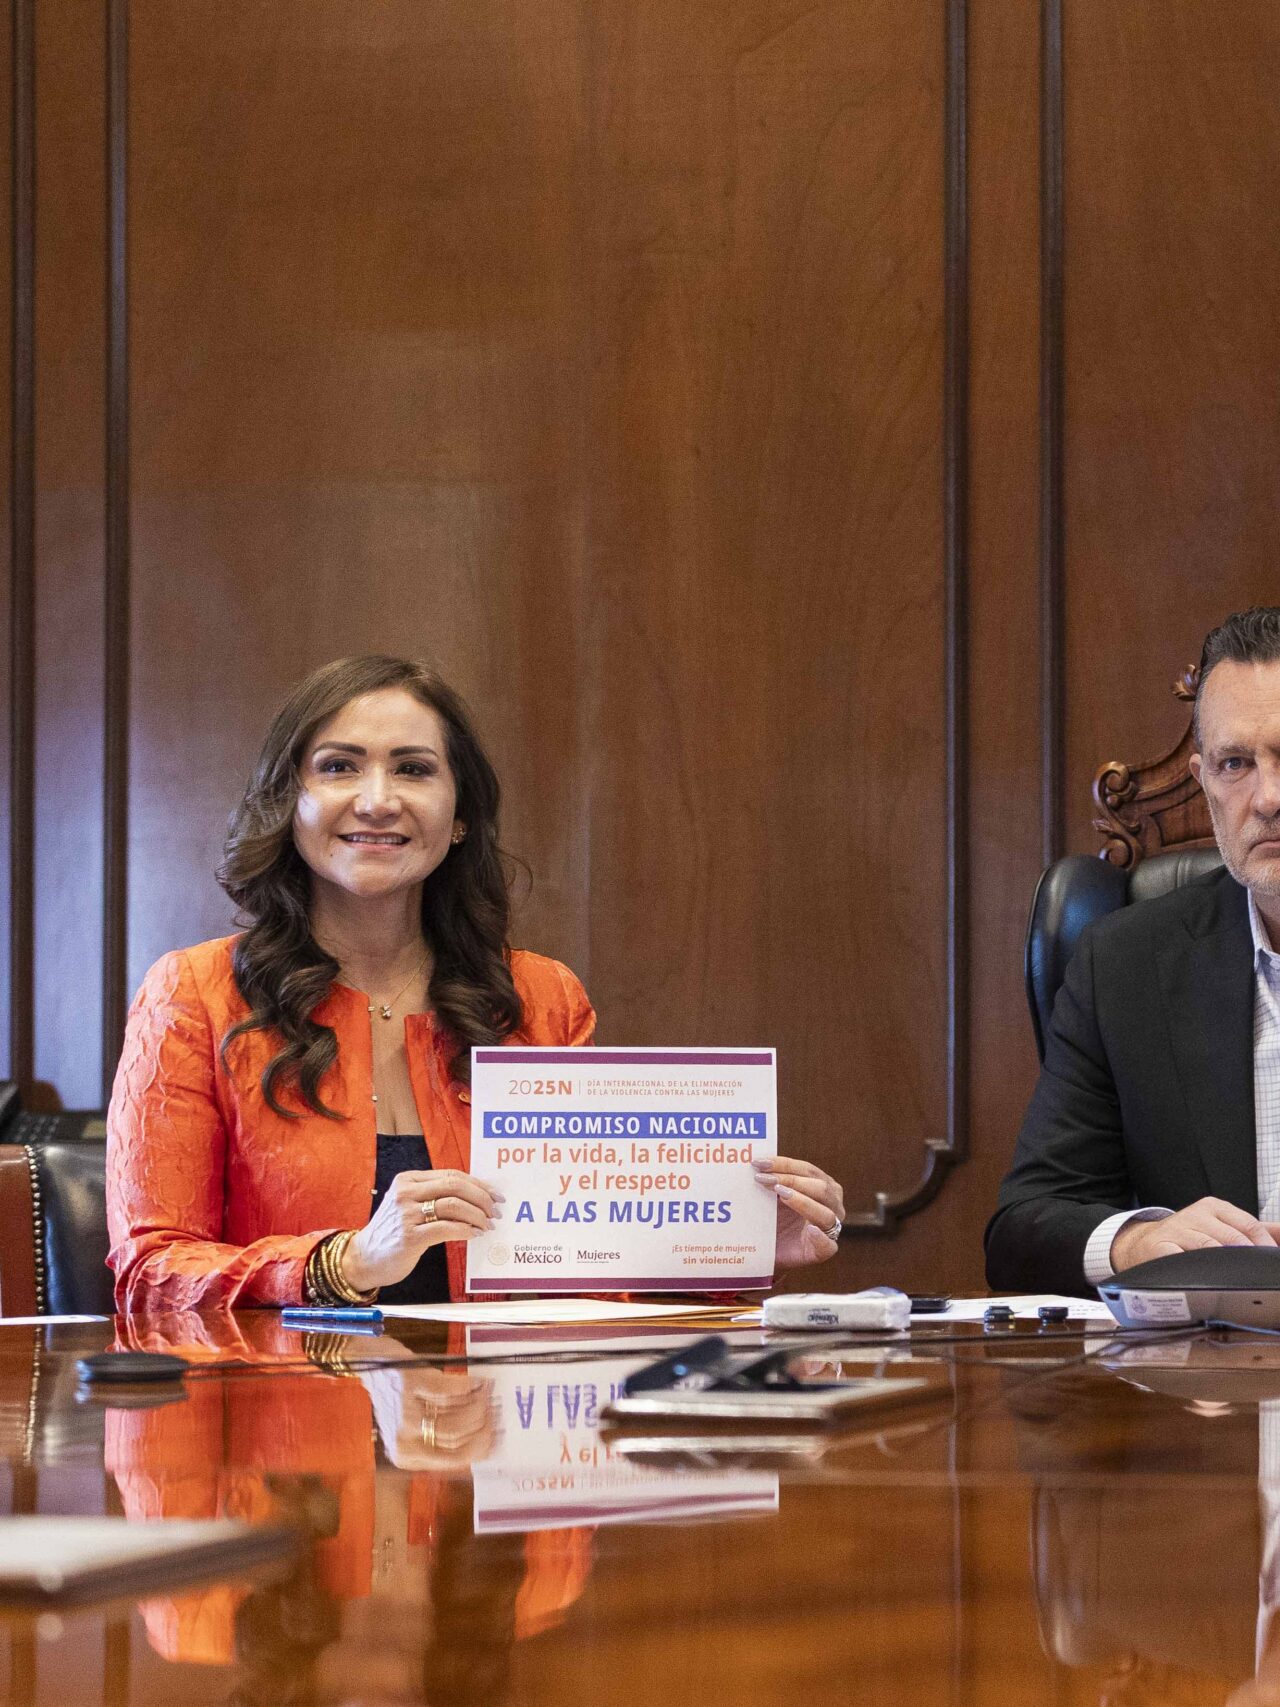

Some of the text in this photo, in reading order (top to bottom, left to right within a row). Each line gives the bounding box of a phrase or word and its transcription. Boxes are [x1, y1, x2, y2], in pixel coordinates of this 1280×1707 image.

[508, 1079, 572, 1095] 2025N
[587, 1079, 601, 1087] DÍA
[691, 1079, 742, 1087] ELIMINACIÓN
[491, 1116, 759, 1135] COMPROMISO NACIONAL
[497, 1143, 752, 1168] por la vida, la felicidad
[559, 1169, 690, 1195] y el respeto
[516, 1201, 732, 1229] A LAS MUJERES
[577, 1250, 620, 1261] Mujeres
[684, 1244, 714, 1254] tiempo
[714, 1244, 723, 1252] de
[725, 1244, 756, 1254] mujeres
[513, 1251, 562, 1263] México
[683, 1256, 745, 1264] sin violencia!
